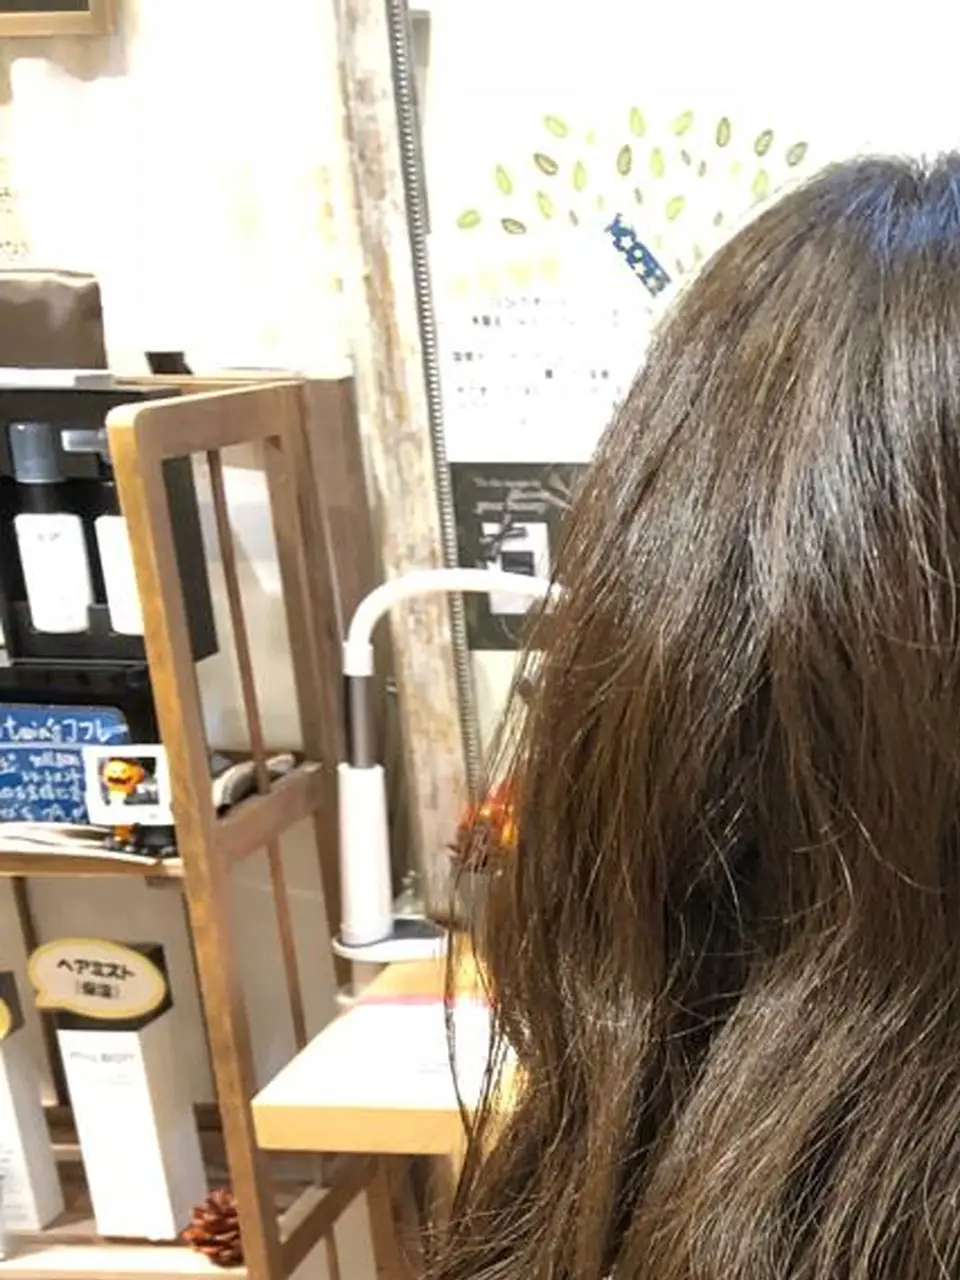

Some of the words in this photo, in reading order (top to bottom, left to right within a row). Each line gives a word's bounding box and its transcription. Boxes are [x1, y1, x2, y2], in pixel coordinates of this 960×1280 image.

[56, 958, 136, 981] ヘアミスト
